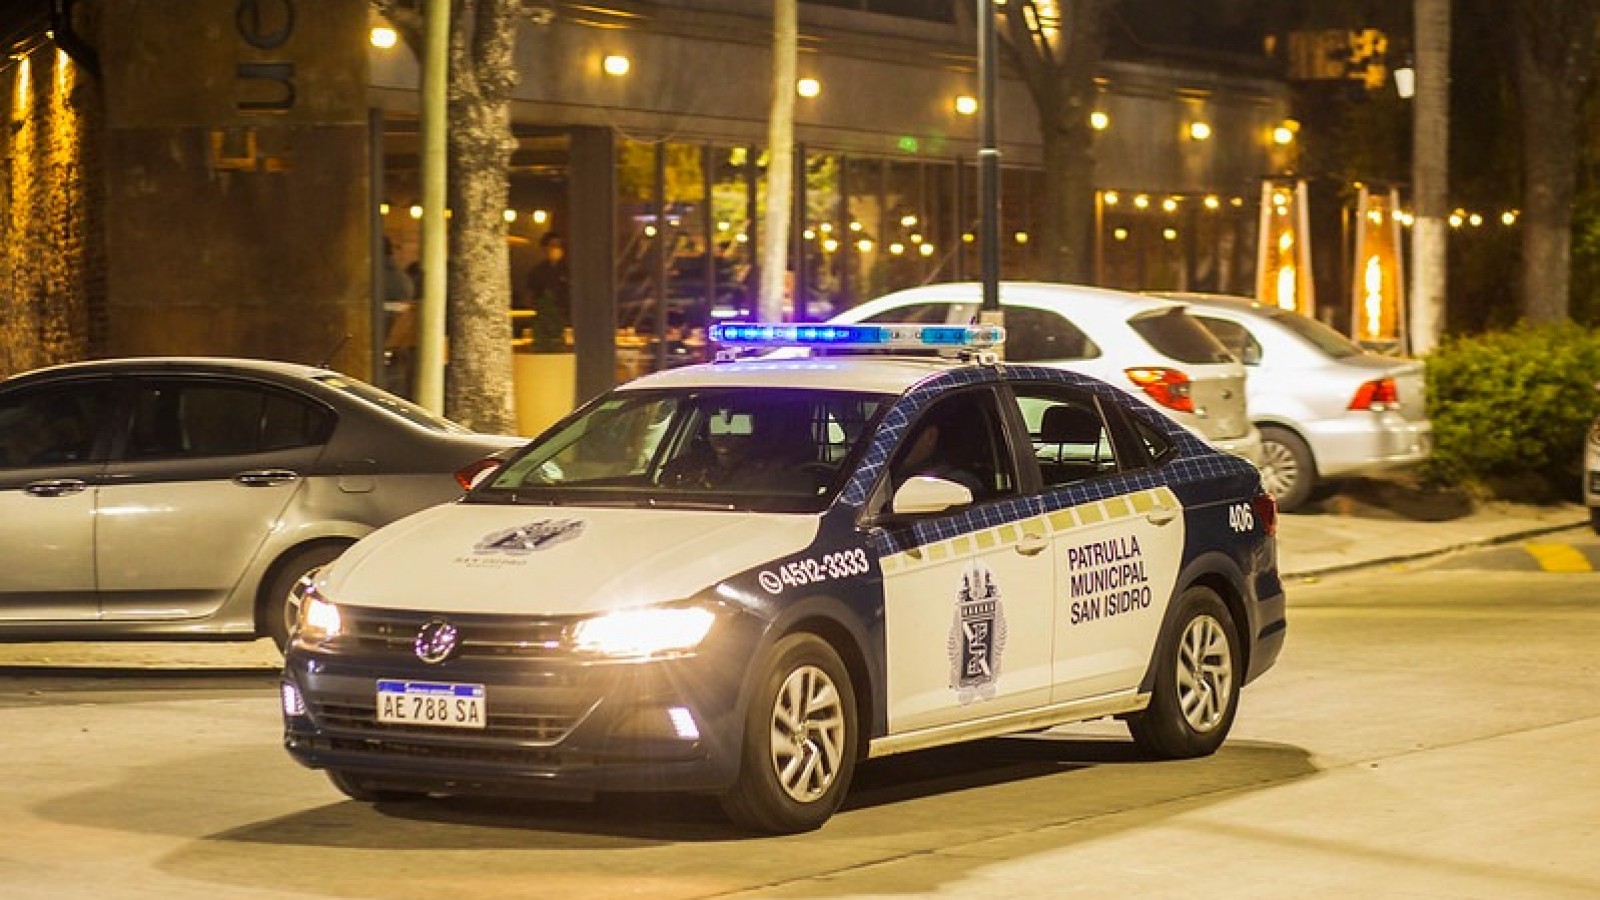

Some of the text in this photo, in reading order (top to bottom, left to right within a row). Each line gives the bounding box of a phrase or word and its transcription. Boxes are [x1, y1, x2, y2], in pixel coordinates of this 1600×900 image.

[1229, 503, 1254, 532] 406
[780, 547, 870, 588] 4512-3333
[1067, 535, 1142, 572] PATRULLA
[1070, 561, 1149, 599] MUNICIPAL
[1070, 585, 1152, 626] SAN ISIDRO
[383, 695, 480, 723] AE 788 SA
